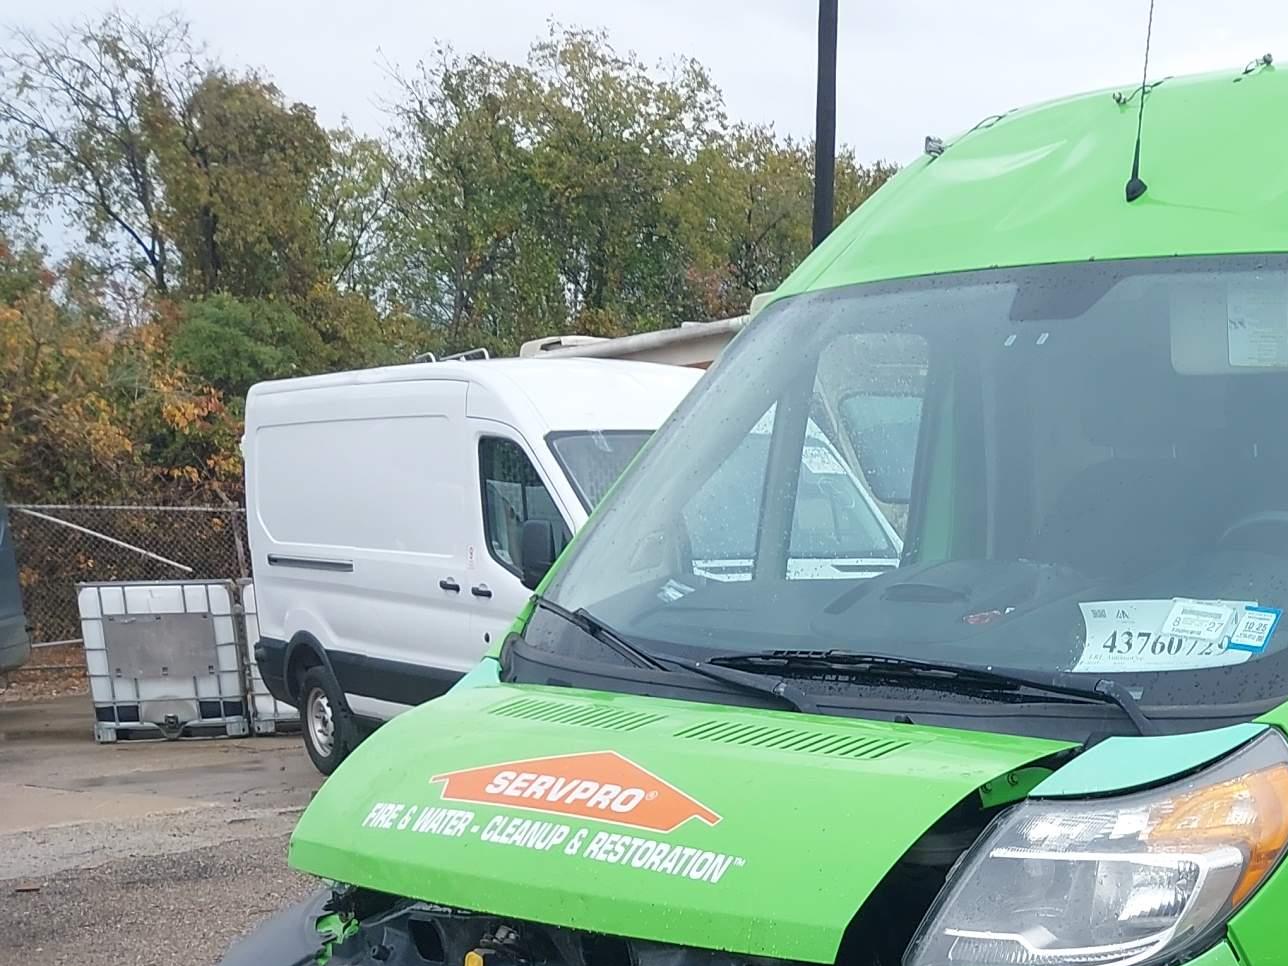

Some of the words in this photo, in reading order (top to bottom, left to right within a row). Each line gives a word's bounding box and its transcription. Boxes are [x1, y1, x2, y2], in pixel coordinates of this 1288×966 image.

[362, 802, 400, 829] FIRE
[400, 807, 413, 831] &
[412, 807, 471, 838] WATER
[480, 815, 567, 851] CLEANUP
[567, 829, 587, 855] &
